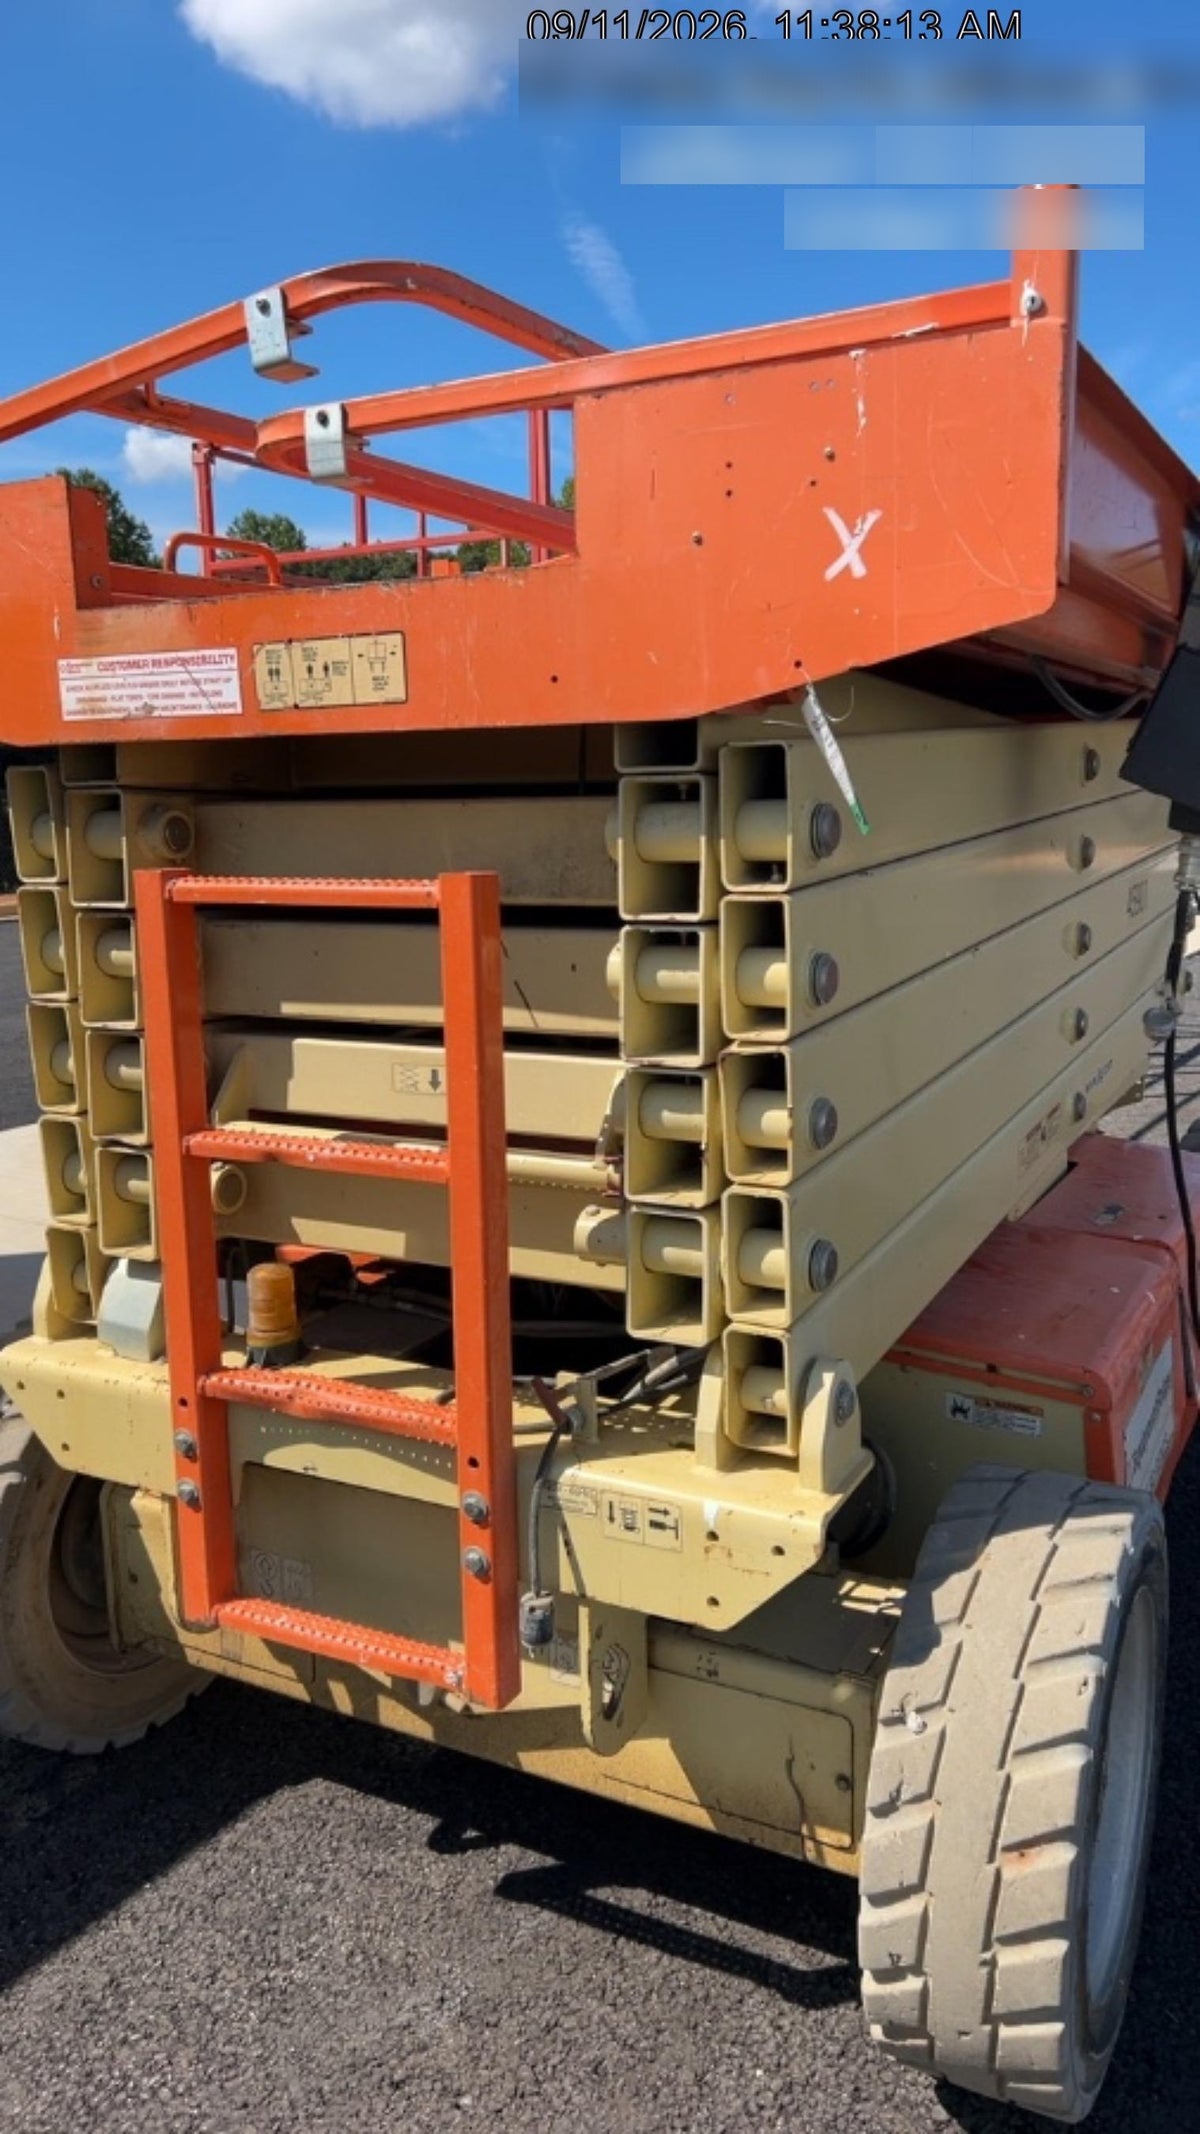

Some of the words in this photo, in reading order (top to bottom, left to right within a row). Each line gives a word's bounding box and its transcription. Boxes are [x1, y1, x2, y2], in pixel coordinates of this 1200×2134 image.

[822, 506, 883, 582] X
[97, 658, 150, 673] CUSTOMER
[151, 653, 236, 669] RESPONSIBILITY
